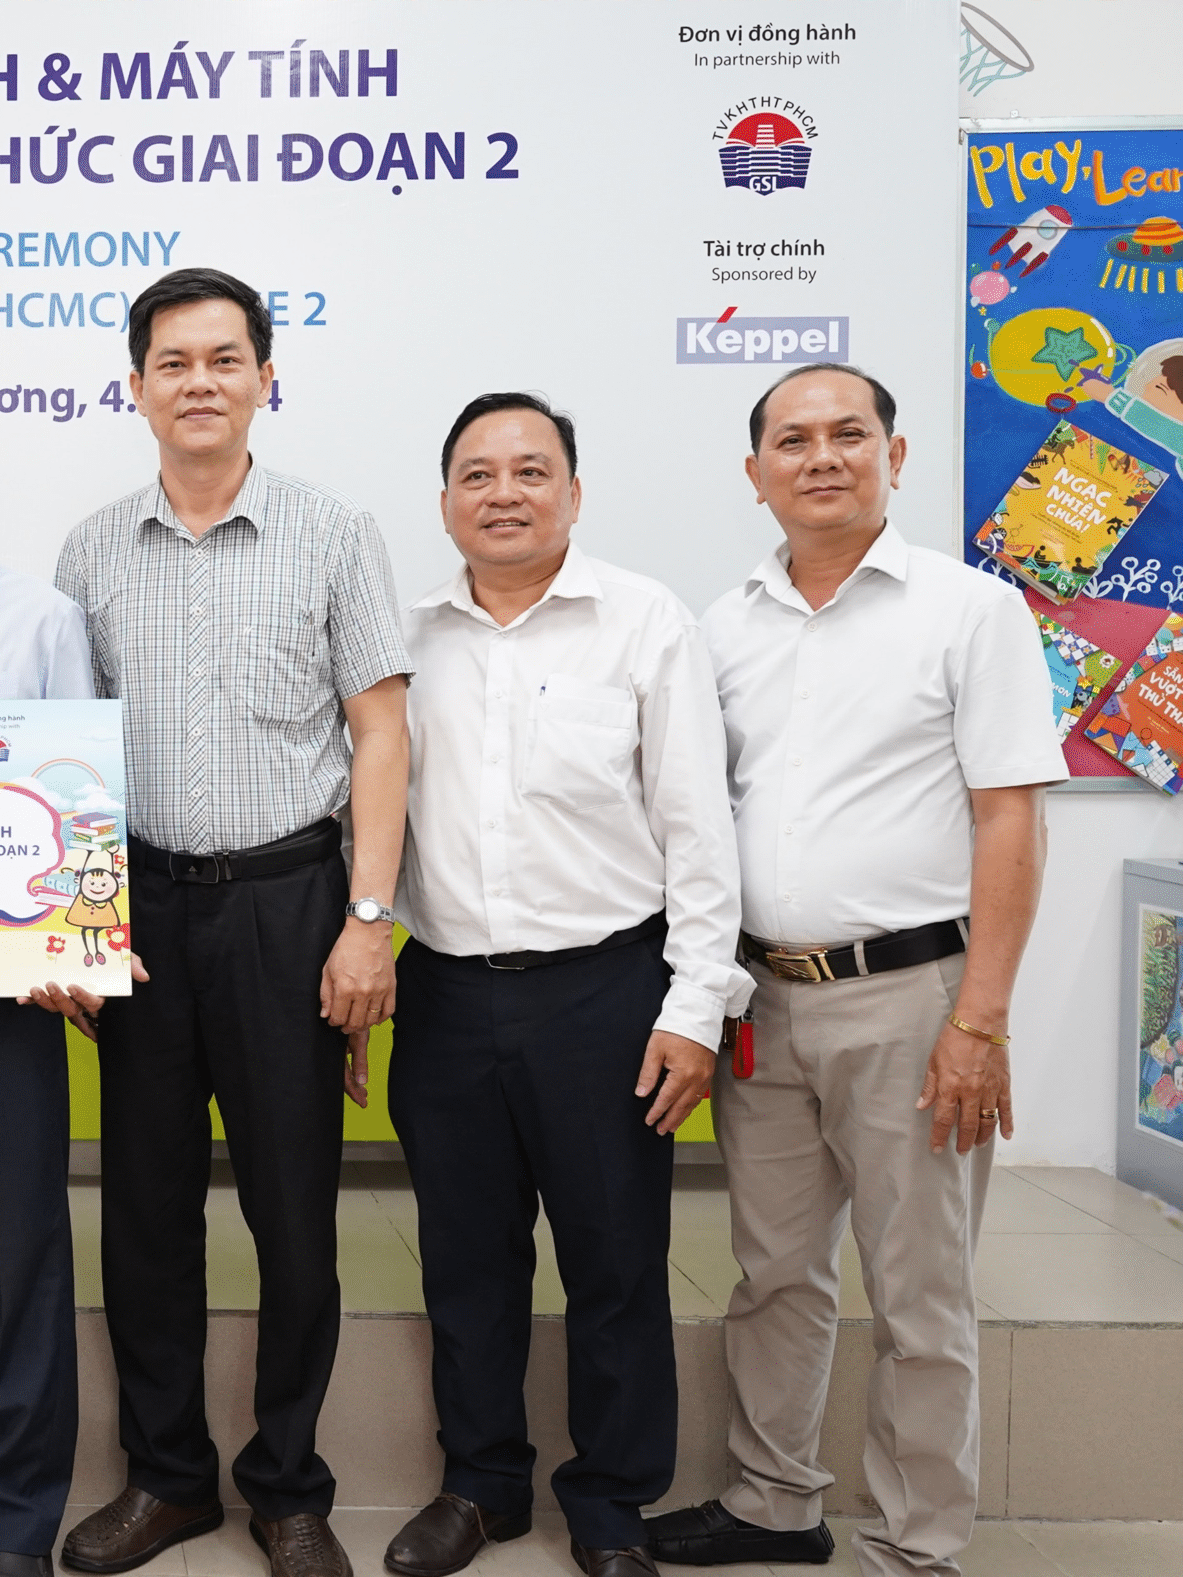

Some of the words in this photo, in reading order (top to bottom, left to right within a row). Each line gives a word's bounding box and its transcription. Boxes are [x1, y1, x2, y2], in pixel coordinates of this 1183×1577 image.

[679, 26, 719, 42] Đơn
[726, 25, 742, 46] vị
[749, 23, 799, 45] đồng
[807, 23, 855, 40] hành
[38, 53, 82, 101] &
[100, 41, 235, 100] MÁY
[248, 39, 397, 98] TÍNH
[695, 54, 708, 66] In
[714, 52, 802, 69] partnership
[807, 51, 839, 64] with
[712, 96, 819, 141] TVKHTHTPHCM
[133, 134, 258, 183] GIAI
[277, 132, 465, 195] ĐOẠN
[486, 132, 519, 179] 2
[970, 139, 1092, 209] Play,
[748, 175, 778, 194] GSL
[703, 240, 730, 256] Tài
[737, 242, 766, 260] trợ
[771, 239, 824, 256] chính
[712, 267, 793, 284] Sponsored
[799, 267, 816, 284] by
[303, 292, 326, 326] 2
[686, 307, 839, 360] Keppel
[1046, 484, 1107, 525] NHIÊN
[1054, 467, 1112, 508] NGẠC
[33, 845, 39, 856] 2
